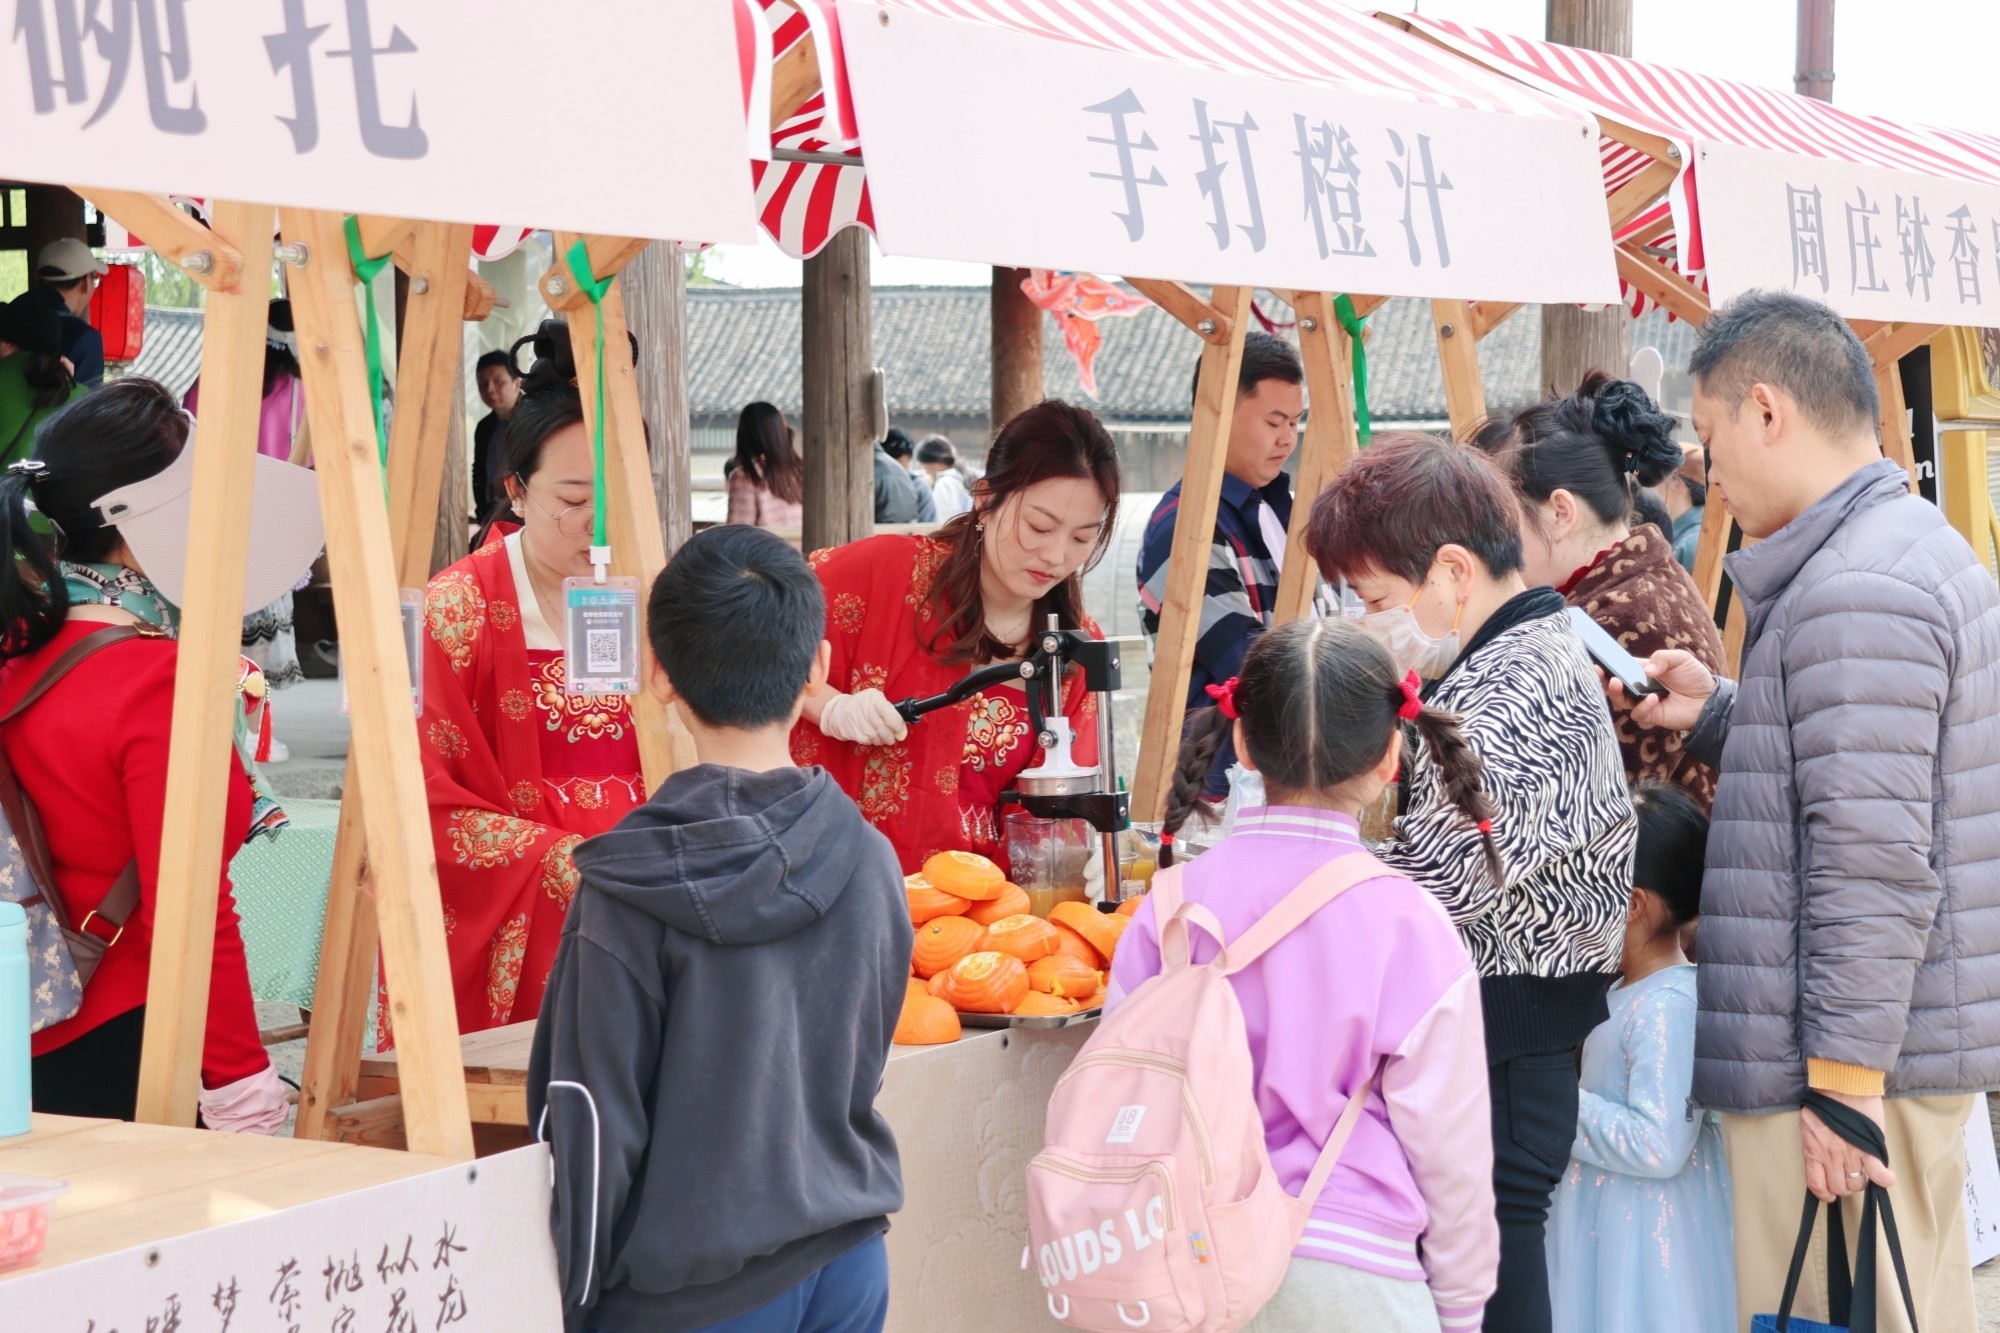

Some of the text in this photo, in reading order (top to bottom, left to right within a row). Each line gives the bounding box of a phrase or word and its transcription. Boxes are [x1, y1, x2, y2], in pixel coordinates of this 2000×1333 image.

[1081, 87, 1454, 269] 手打橙汁
[1786, 182, 2000, 305] 周庄钵香
